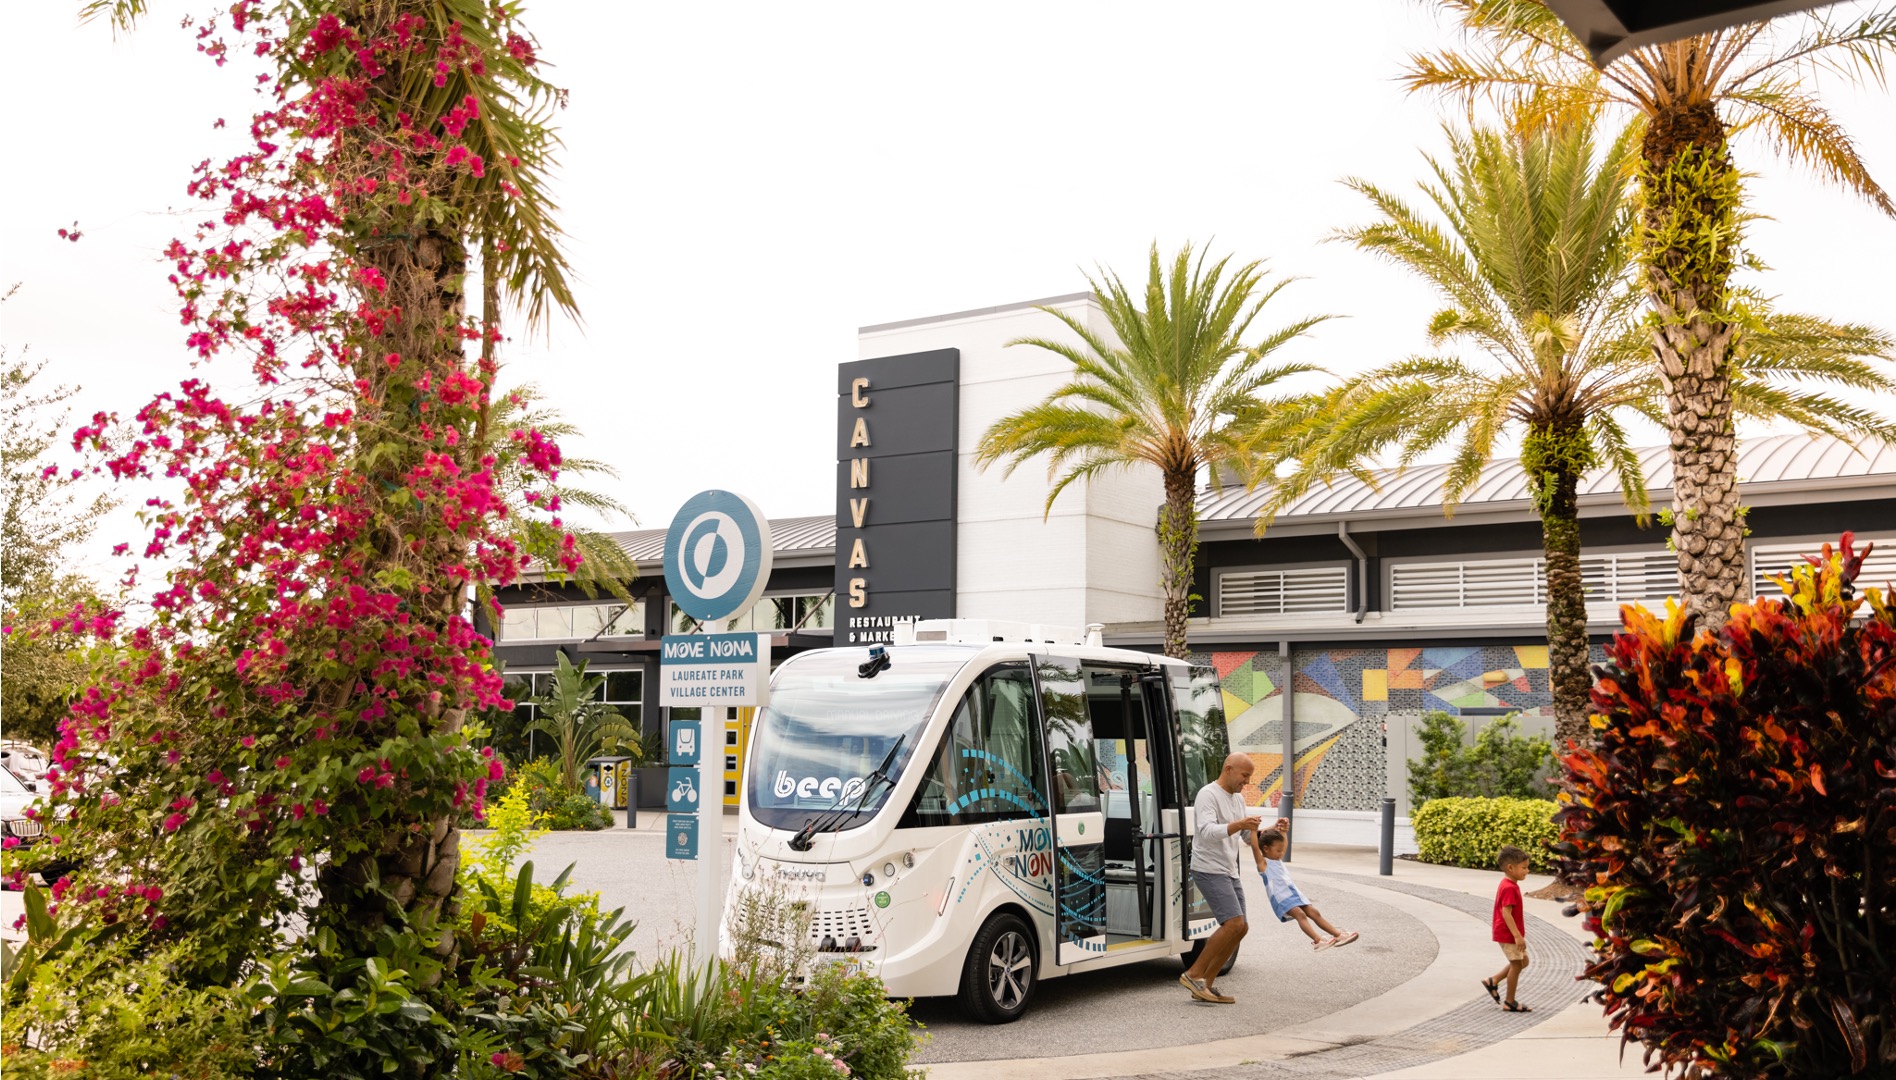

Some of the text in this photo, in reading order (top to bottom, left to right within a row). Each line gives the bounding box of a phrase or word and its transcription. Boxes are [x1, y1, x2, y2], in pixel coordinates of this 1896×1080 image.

[848, 377, 872, 608] CANVAS
[849, 631, 894, 642] & MARKE
[664, 640, 753, 658] MOVE NONA
[672, 669, 744, 681] LAUREATE PARK
[670, 686, 745, 697] VILLAGE CENTER
[774, 770, 866, 806] beep
[1019, 828, 1052, 853] MOV
[1014, 852, 1053, 878] NON
